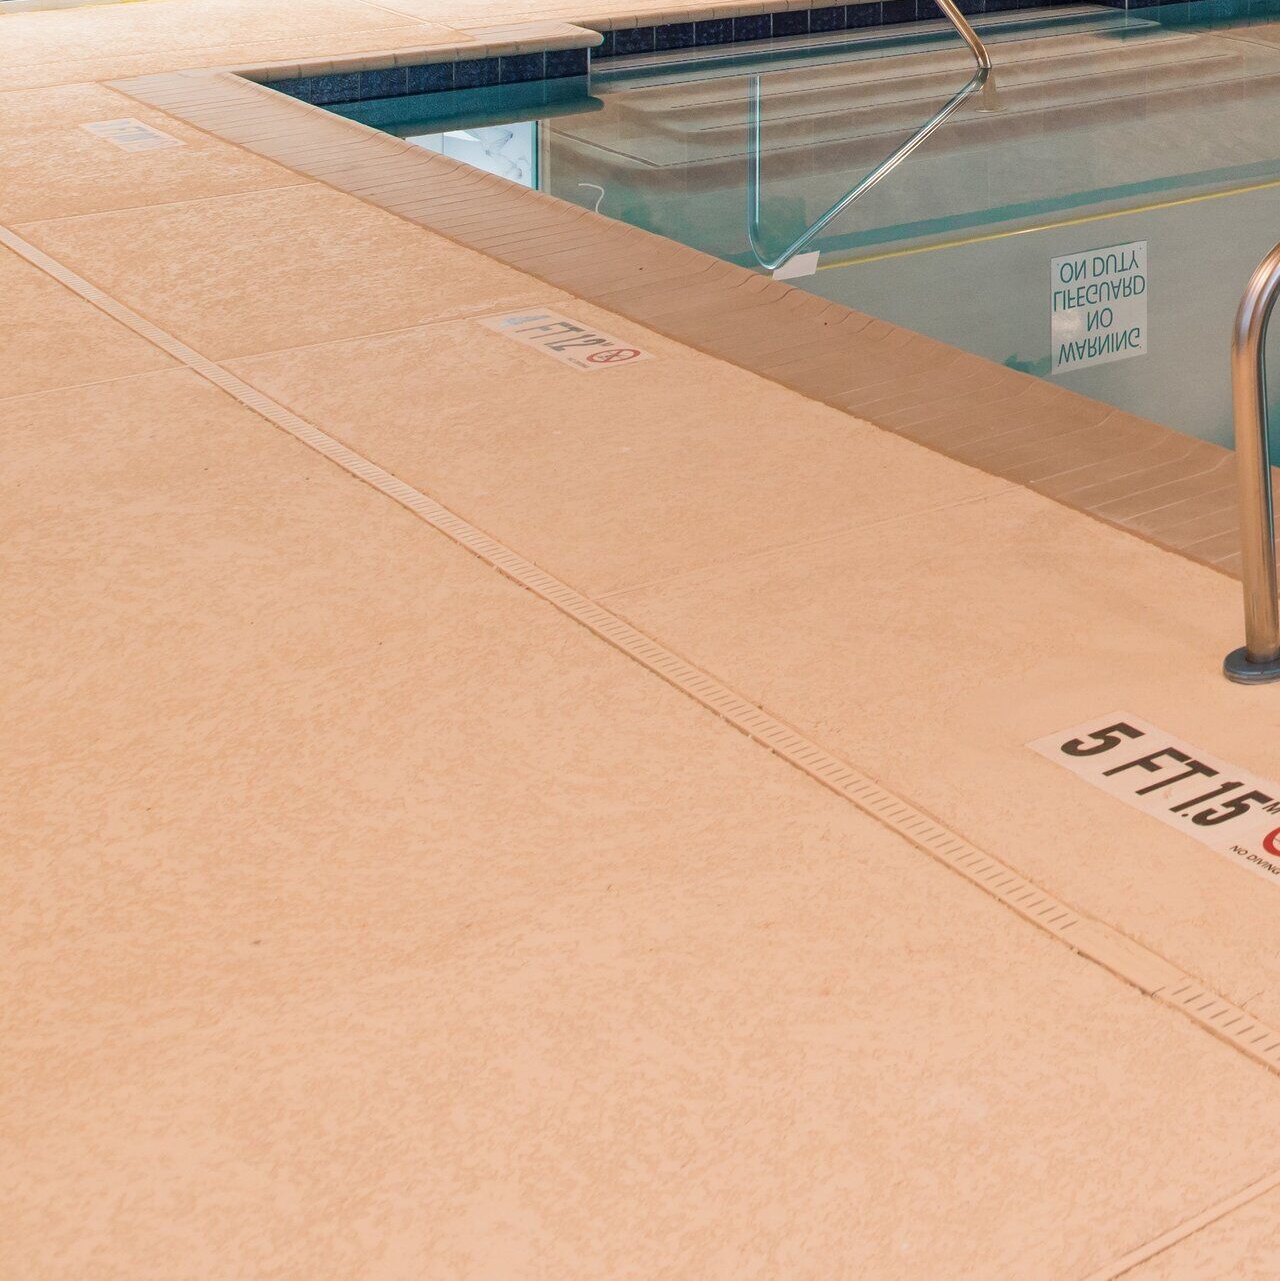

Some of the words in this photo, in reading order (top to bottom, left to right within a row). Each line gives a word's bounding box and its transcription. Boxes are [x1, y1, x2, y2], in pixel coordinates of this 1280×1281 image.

[514, 322, 585, 339] FT
[1060, 721, 1147, 757] 5
[1101, 746, 1220, 796] FT
[1229, 845, 1248, 855] NO
